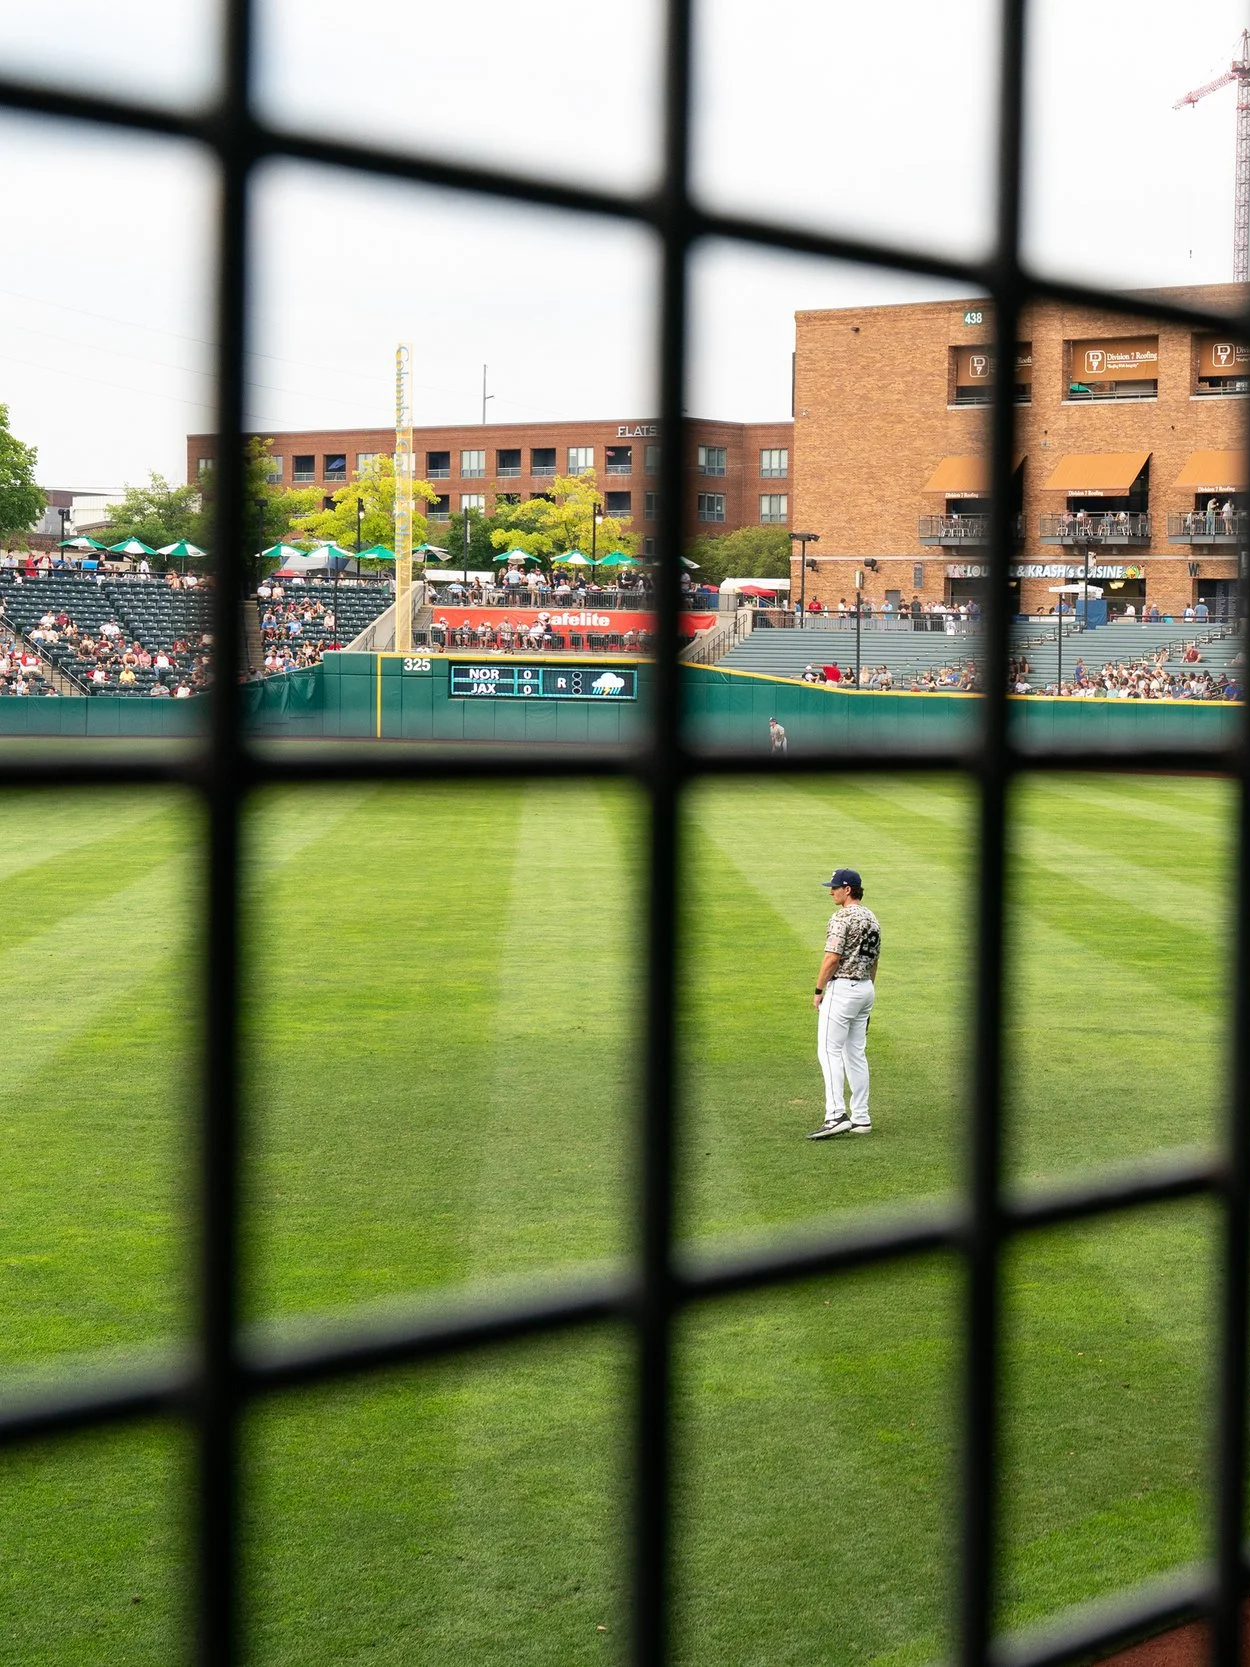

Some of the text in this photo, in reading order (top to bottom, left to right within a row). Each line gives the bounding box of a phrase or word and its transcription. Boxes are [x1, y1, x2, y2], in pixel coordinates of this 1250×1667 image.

[965, 313, 983, 324] 438
[1107, 353, 1130, 361] Division
[1136, 351, 1157, 360] Roofing
[618, 426, 657, 437] FLATS
[1016, 567, 1025, 577] &
[1027, 564, 1074, 578] KRASH's
[538, 612, 611, 627] Safelite
[404, 658, 431, 672] 325
[469, 669, 532, 680] NOR 0
[557, 678, 567, 689] R
[470, 684, 532, 695] JAX 0
